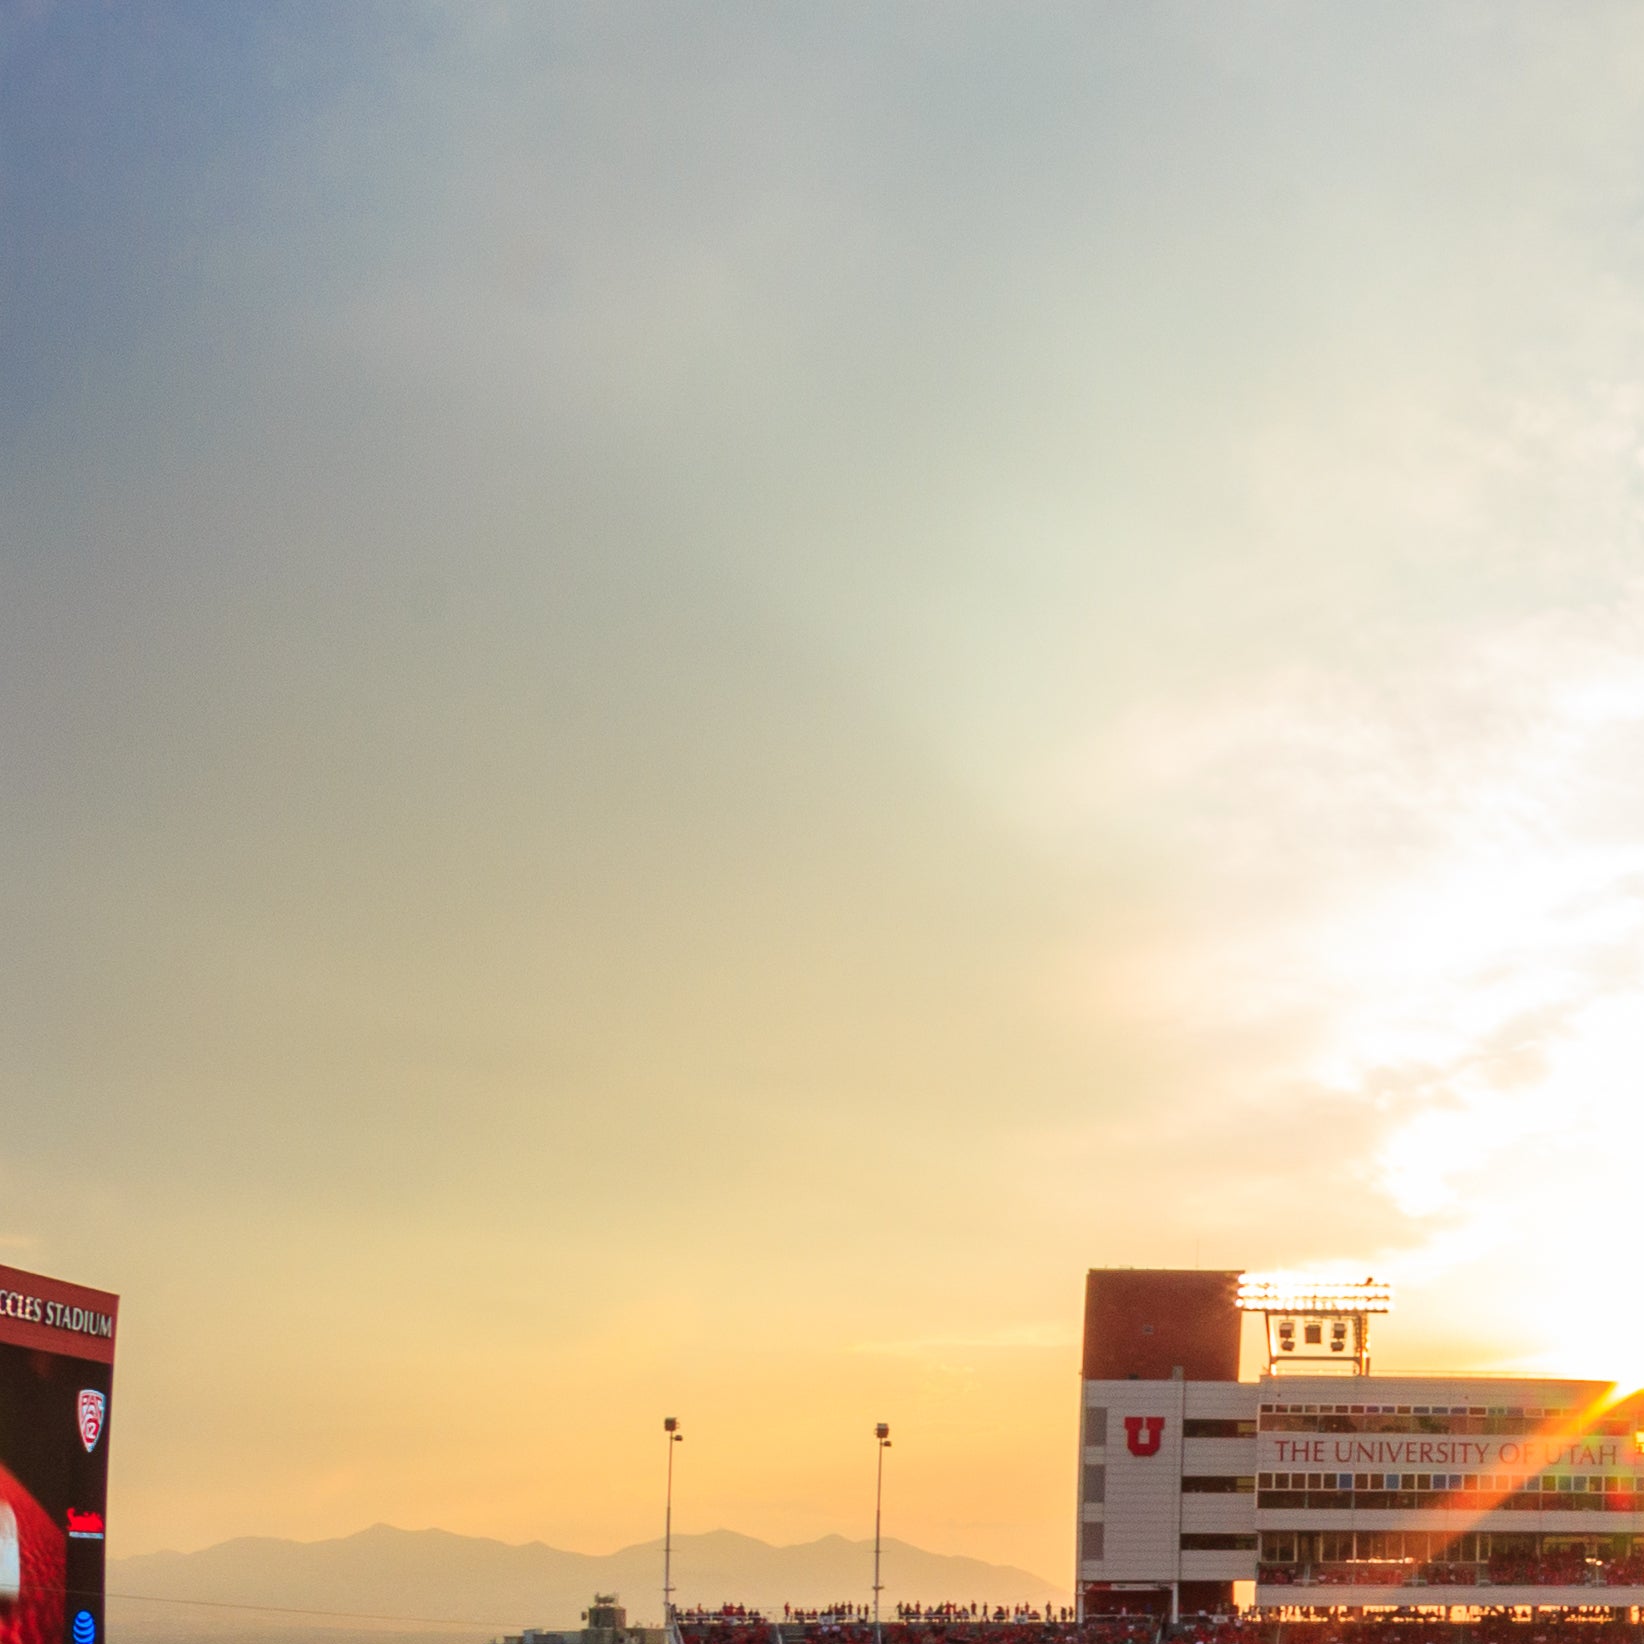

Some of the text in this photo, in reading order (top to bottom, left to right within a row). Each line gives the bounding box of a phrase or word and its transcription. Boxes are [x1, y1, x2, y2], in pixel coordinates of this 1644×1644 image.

[45, 1301, 112, 1338] STADIUM
[1124, 1417, 1164, 1457] U
[1275, 1440, 1617, 1467] THE UNIVERSITY OF UTAH
